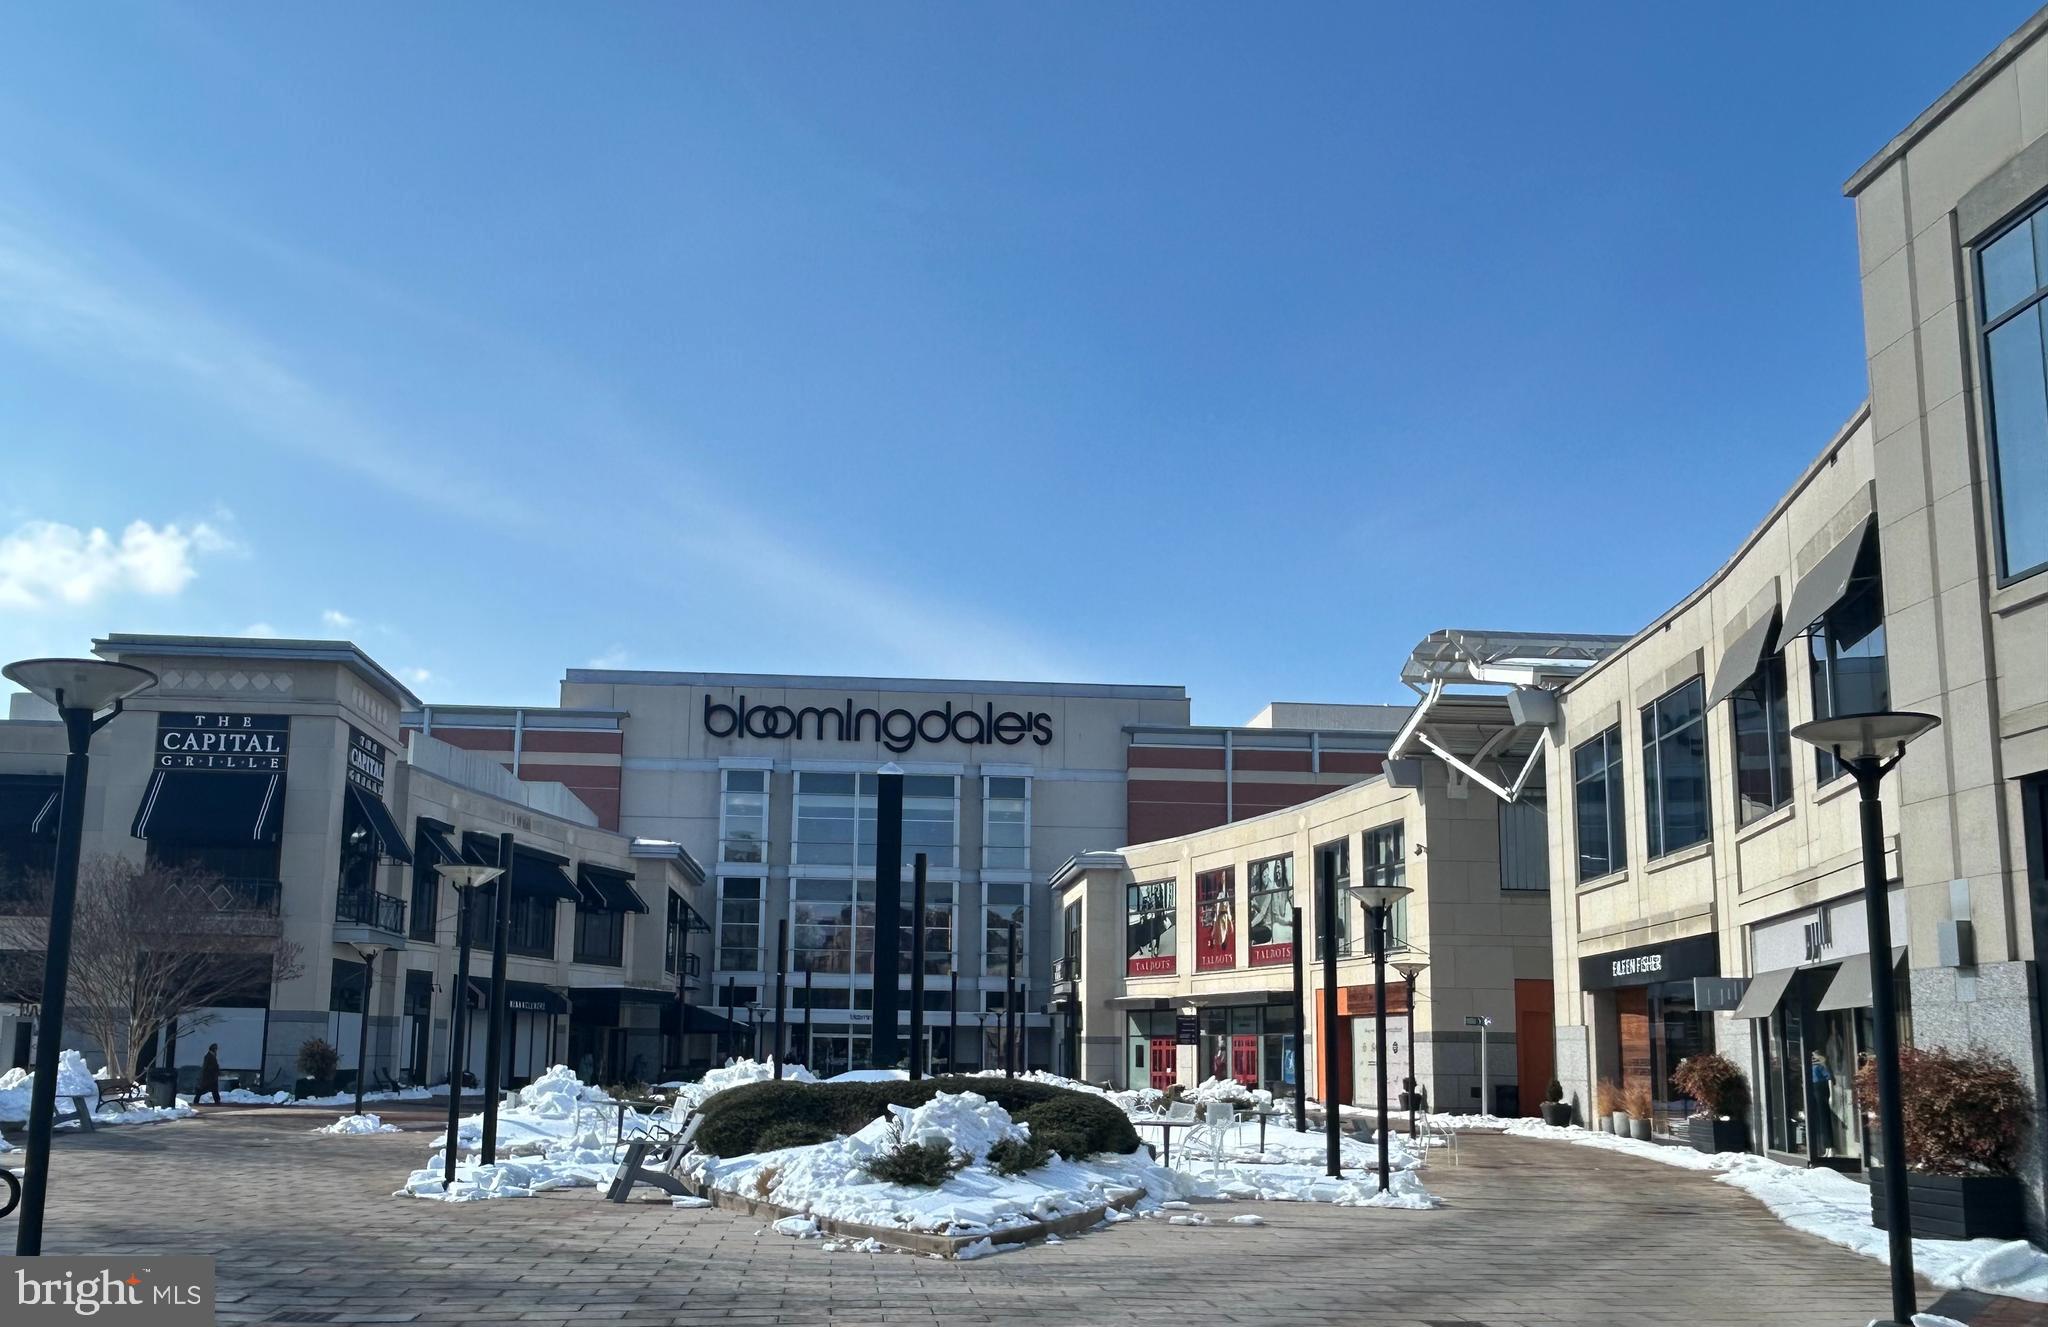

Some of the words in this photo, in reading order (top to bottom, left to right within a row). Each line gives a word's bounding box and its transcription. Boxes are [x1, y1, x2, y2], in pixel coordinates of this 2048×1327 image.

[195, 715, 252, 727] THE
[704, 694, 1053, 753] bloomingdale's
[163, 732, 280, 753] CAPITAL
[351, 748, 384, 781] CAPITAL
[1202, 954, 1233, 965] TALBOTS
[1256, 947, 1291, 960] TALBOTS
[1135, 960, 1170, 971] TALBOTS
